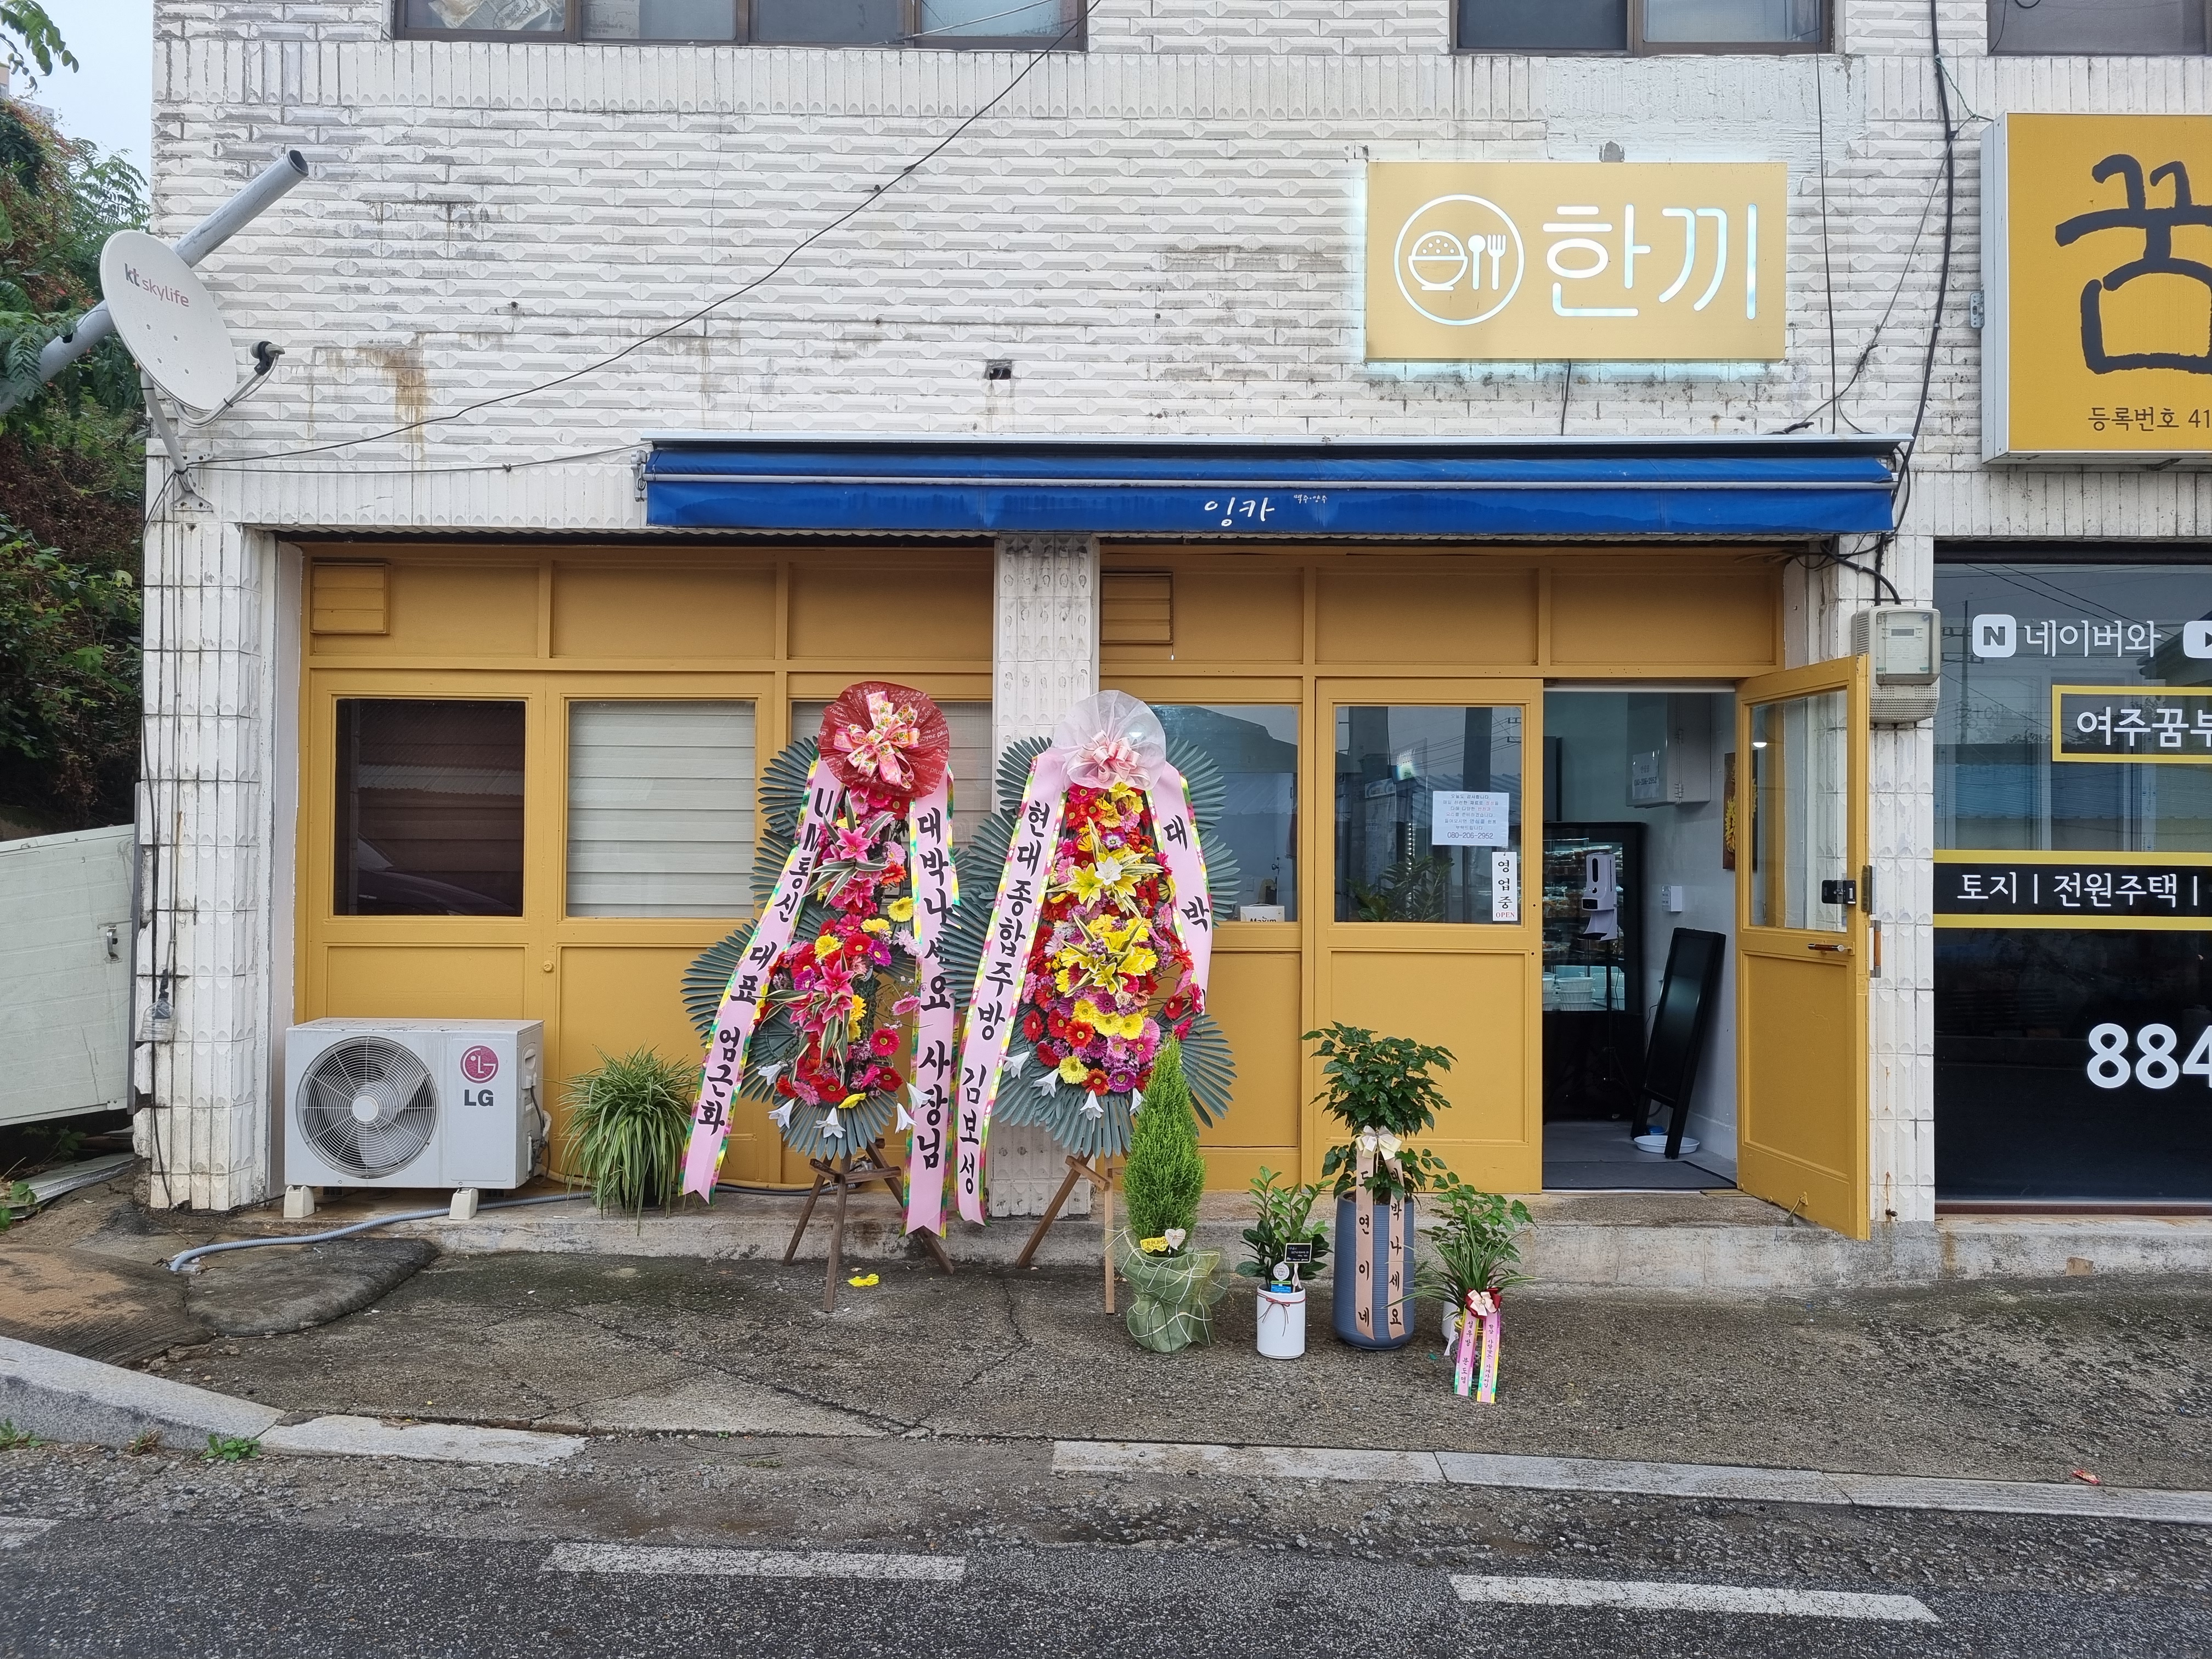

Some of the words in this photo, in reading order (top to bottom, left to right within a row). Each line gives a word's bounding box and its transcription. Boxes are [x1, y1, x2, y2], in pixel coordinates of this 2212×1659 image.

[124, 263, 140, 287] kt
[142, 278, 189, 308] skylife
[1542, 203, 1757, 321] 한끼
[2087, 407, 2180, 432] 등록번호
[1204, 497, 1275, 527] 잉카
[2024, 620, 2162, 658] 네이버와
[1497, 860, 1513, 909] 영업중
[1957, 871, 2017, 904] 토지
[2053, 872, 2177, 909] 전원주택
[977, 800, 1051, 1041] 현대종합주방
[730, 941, 777, 1006] 대표
[698, 1026, 741, 1136] 엄근화
[2086, 1023, 2212, 1089] 884
[464, 1089, 494, 1107] LG
[917, 1041, 950, 1170] 사장님
[959, 1064, 987, 1195] 김보성
